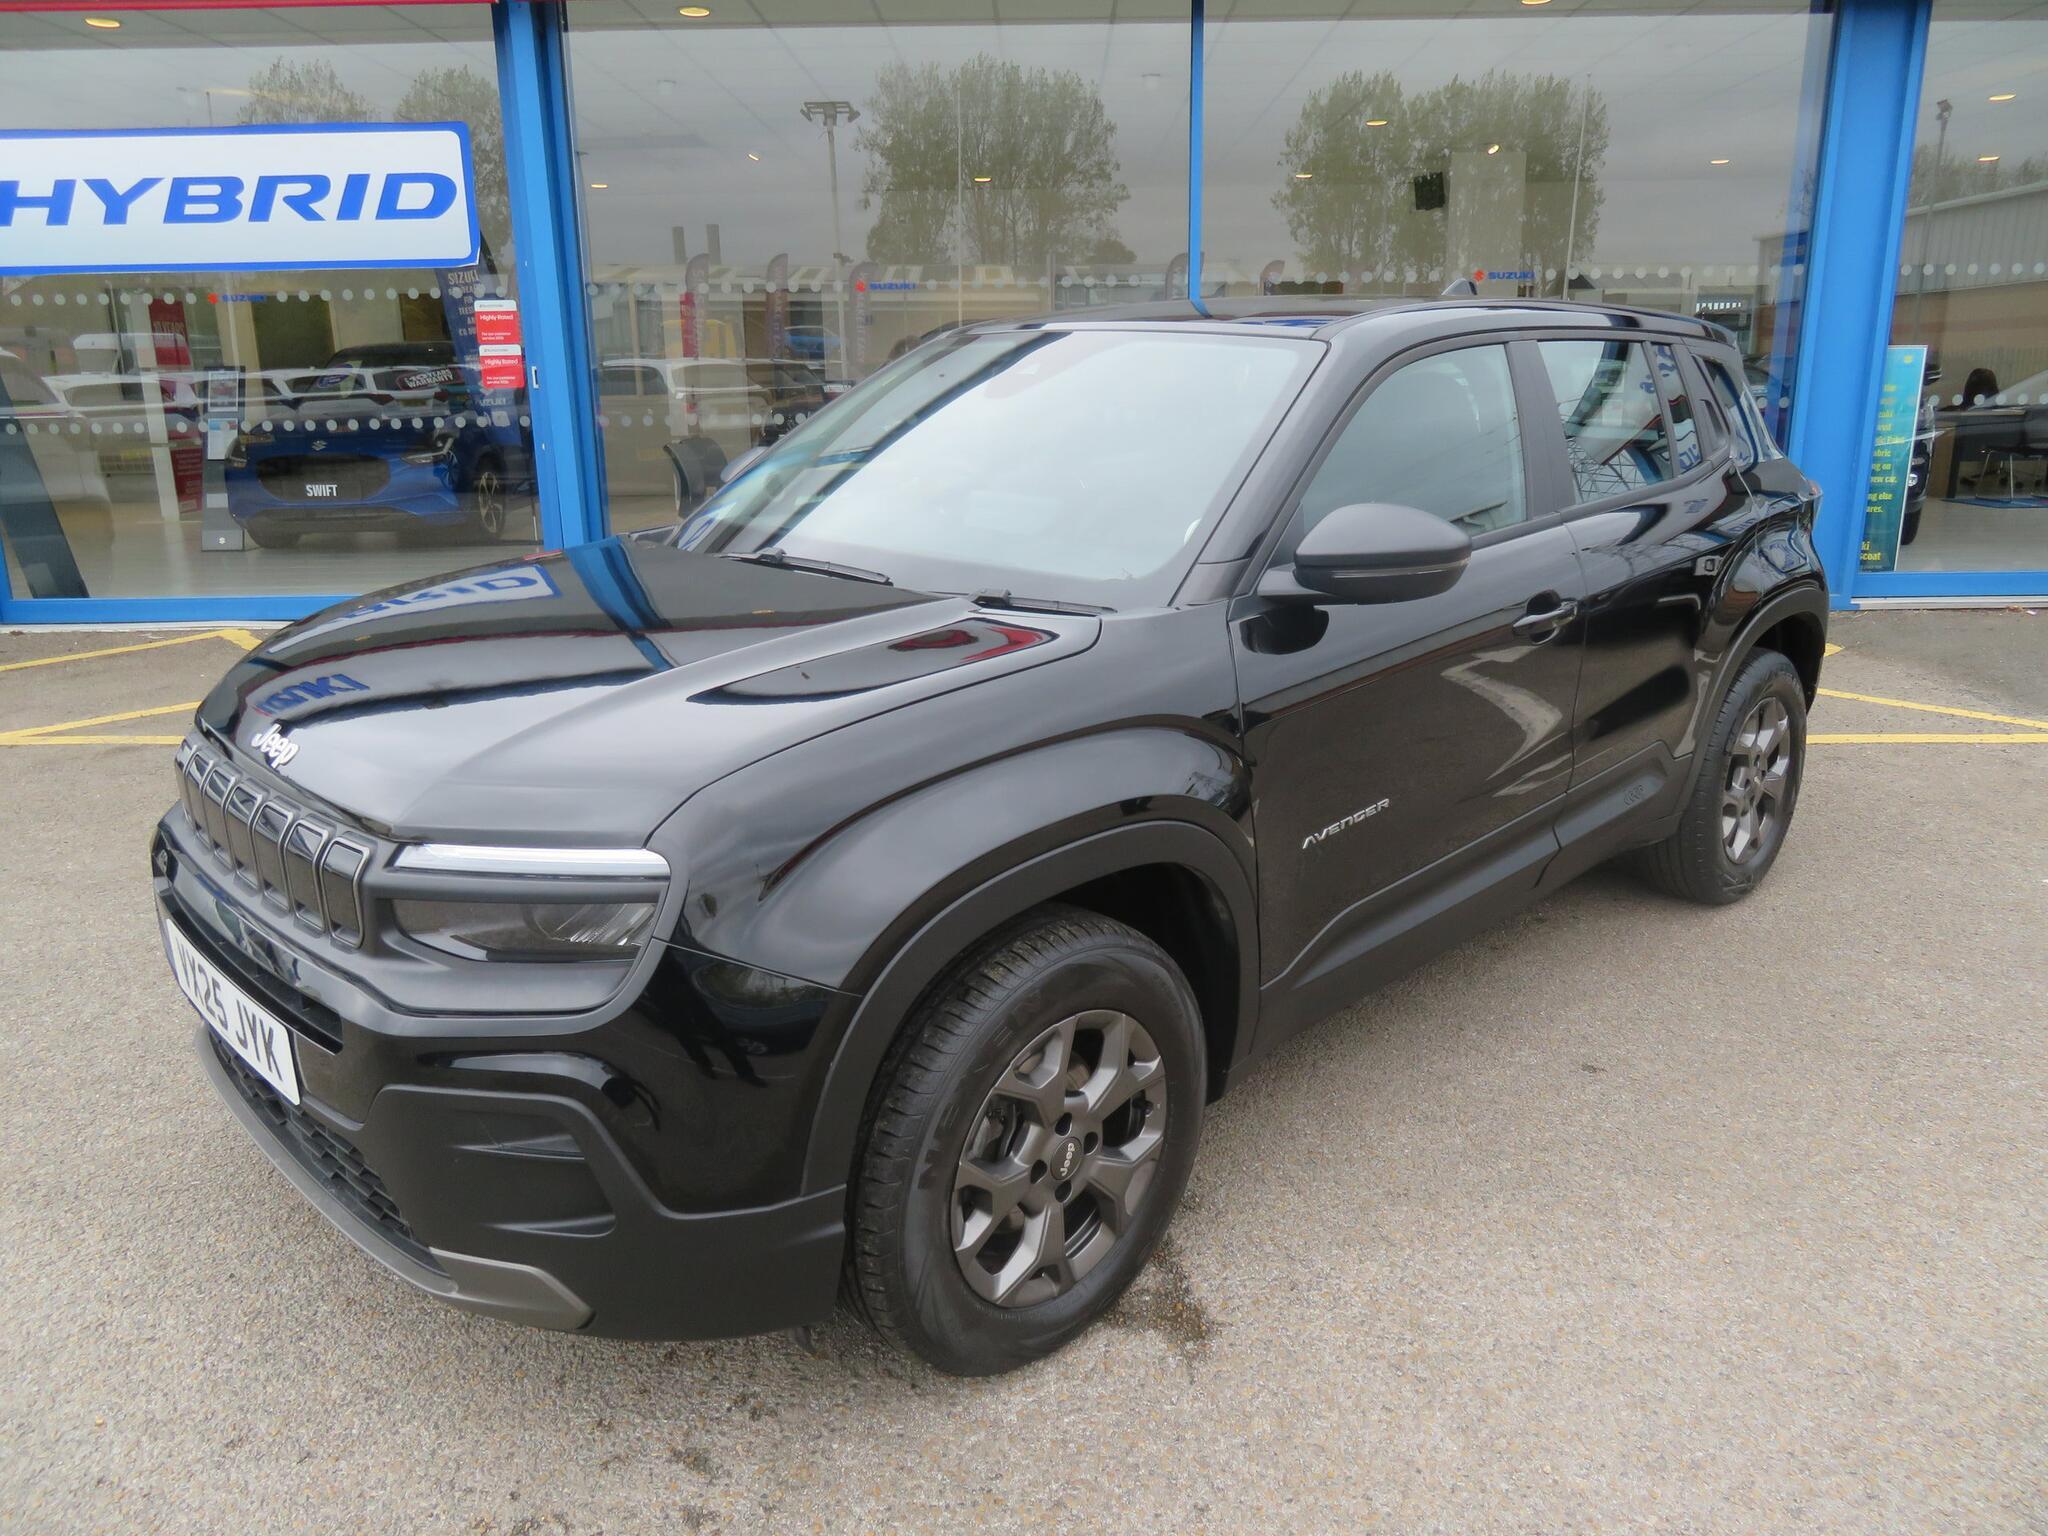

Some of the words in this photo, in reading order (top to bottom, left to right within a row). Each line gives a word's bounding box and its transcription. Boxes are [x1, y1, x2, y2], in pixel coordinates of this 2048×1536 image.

[0, 174, 457, 225] HYBRID
[870, 282, 916, 290] SUZUKI
[1488, 271, 1536, 280] SUZUKI
[305, 484, 338, 497] SWIFT
[251, 723, 299, 768] Jeep
[1302, 798, 1389, 850] AVENGER
[235, 999, 282, 1081] JYK
[1060, 1142, 1076, 1177] Jeep
